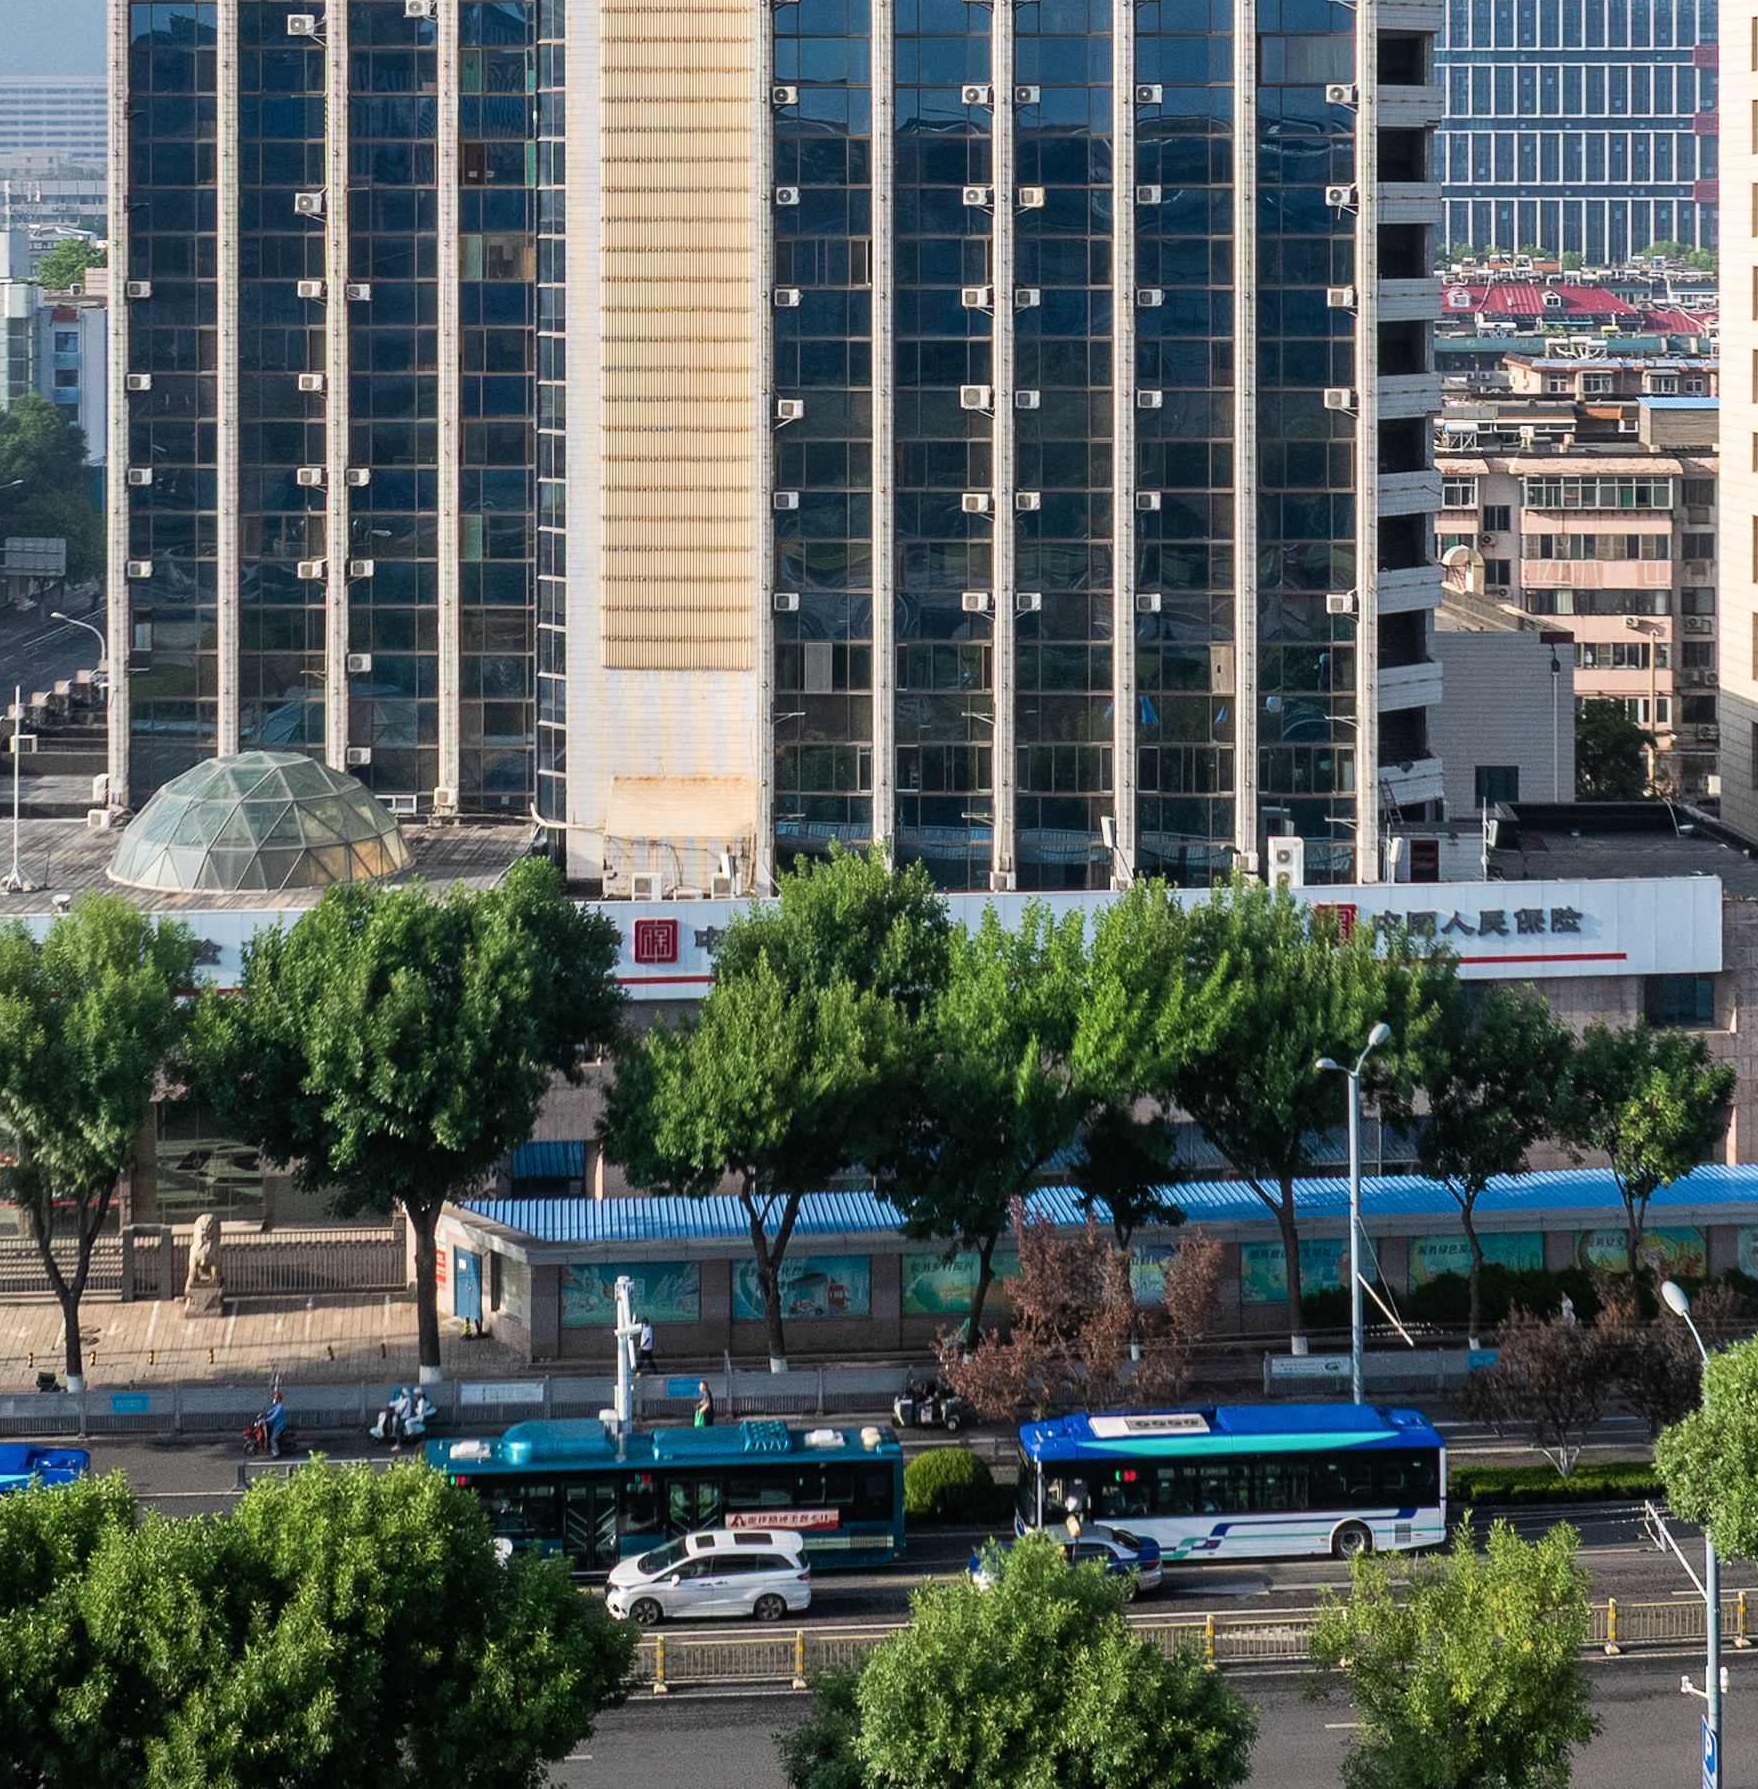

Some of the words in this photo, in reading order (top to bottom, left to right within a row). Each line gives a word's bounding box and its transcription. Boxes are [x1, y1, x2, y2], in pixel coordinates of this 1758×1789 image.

[1373, 906, 1583, 937] 中国人民保险
